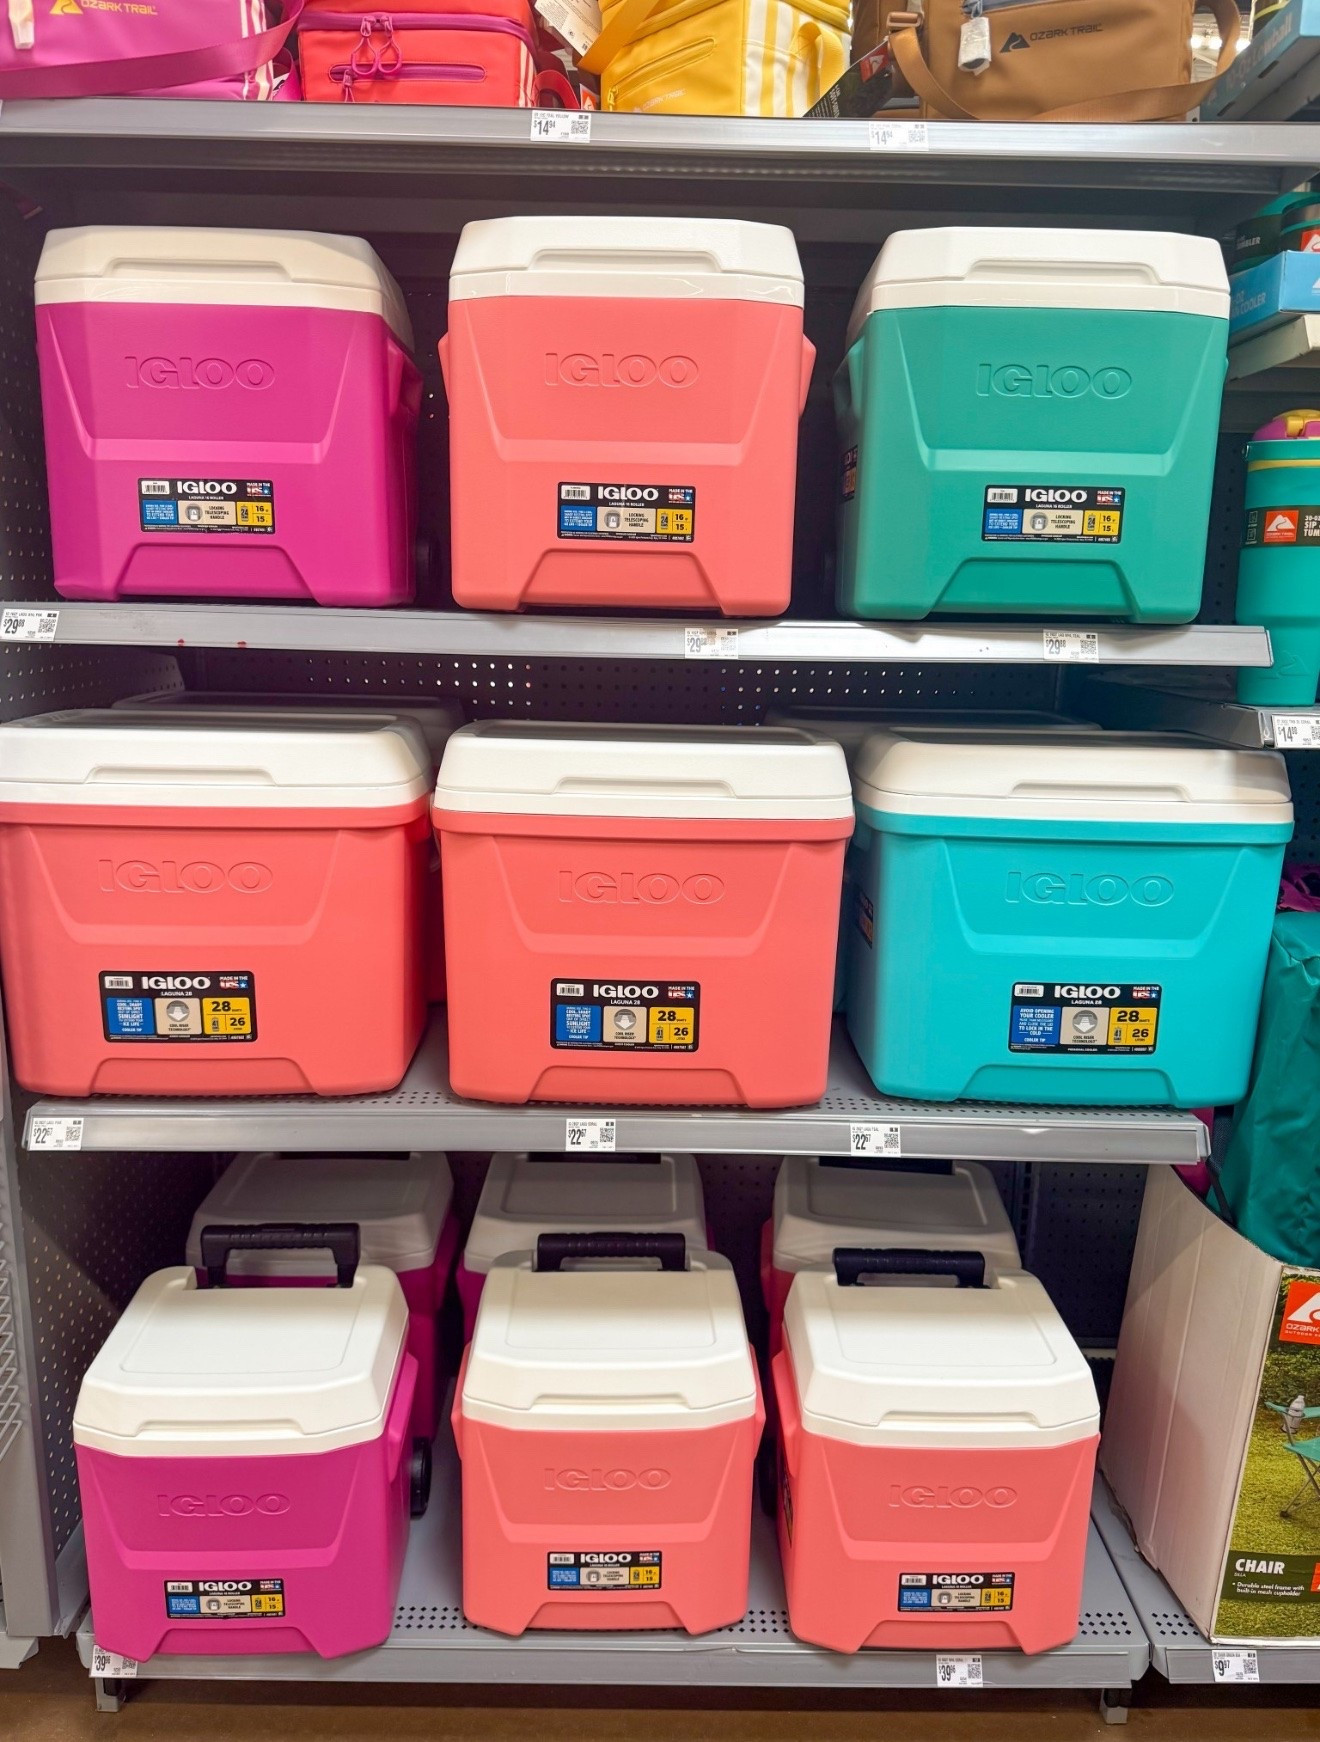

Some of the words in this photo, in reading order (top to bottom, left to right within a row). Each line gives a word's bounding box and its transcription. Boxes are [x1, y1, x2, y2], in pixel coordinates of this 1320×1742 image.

[123, 3, 159, 15] TRAIL
[1030, 28, 1068, 41] OZARK
[1069, 24, 1104, 35] TRAIL
[125, 356, 277, 391] IGLOO
[545, 353, 700, 388] IGLOO
[976, 363, 1133, 400] IGLOO
[177, 481, 237, 495] IGLOO
[598, 486, 659, 501] IGLOO
[1025, 489, 1087, 503] IGLOO
[98, 859, 274, 894] IGLOO
[558, 870, 726, 905] IGLOO
[1005, 872, 1175, 907] IGLOO
[141, 976, 211, 990] IGLOO
[592, 985, 659, 999] IGLOO
[1054, 985, 1121, 999] IGLOO
[211, 1001, 231, 1012] 28
[230, 1017, 245, 1027] 26
[657, 1010, 677, 1021] 28
[1116, 1010, 1139, 1022] 28
[674, 1027, 689, 1036] 26
[1132, 1028, 1149, 1037] 26
[1286, 1323, 1320, 1333] OZARK
[544, 1468, 673, 1491] IGLOO
[888, 1484, 1019, 1509] IGLOO
[157, 1493, 292, 1517] IGLOO
[581, 1553, 632, 1563] IGLOO
[1235, 1558, 1285, 1575] CHAIR
[199, 1581, 252, 1592] IGLOO
[932, 1574, 984, 1585] IGLOO
